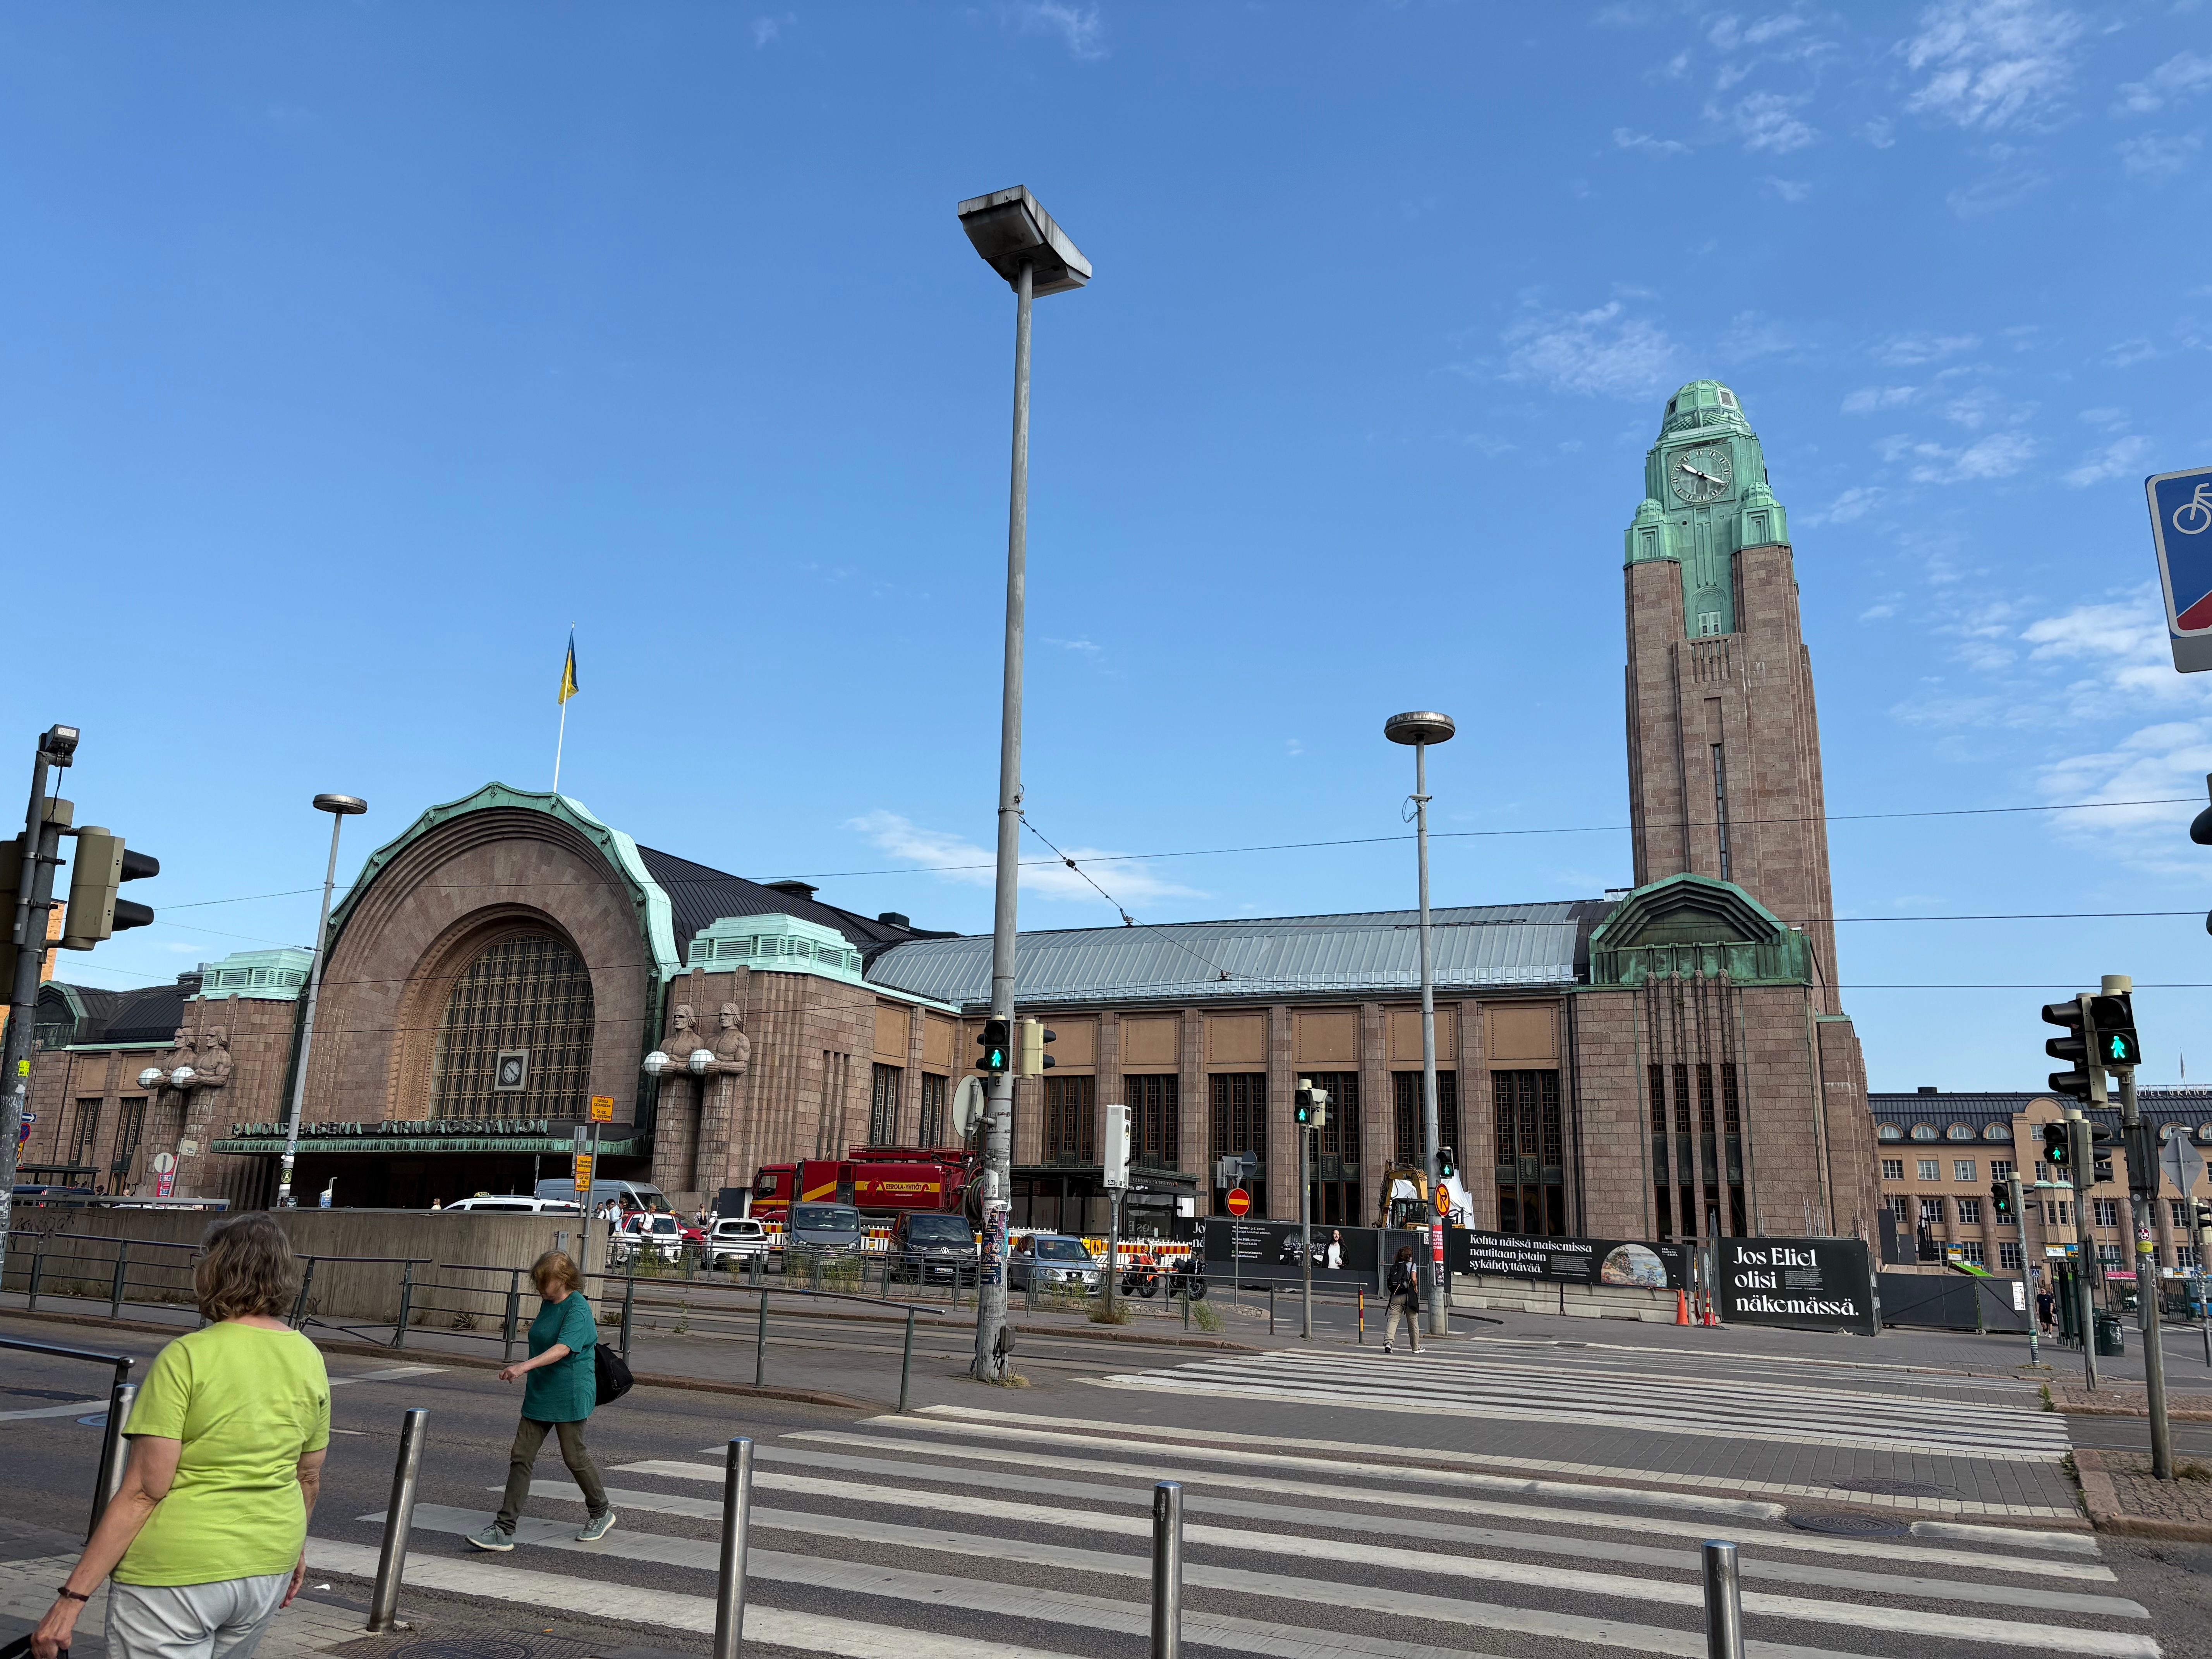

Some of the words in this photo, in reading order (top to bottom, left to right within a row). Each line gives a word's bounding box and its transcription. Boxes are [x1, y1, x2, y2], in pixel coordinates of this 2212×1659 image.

[2136, 1085, 2162, 1096] OTEL
[232, 1121, 362, 1135] RAUTATEASEMA
[1192, 1222, 1206, 1234] Jo
[1470, 1234, 1498, 1245] Kohta
[1499, 1238, 1531, 1248] näissä
[1533, 1240, 1593, 1253] maisemissa
[1470, 1248, 1516, 1259] nautitaan
[1516, 1250, 1547, 1262] jotain
[1733, 1247, 1767, 1265] Jos
[1771, 1247, 1817, 1267] Eliel
[1470, 1259, 1543, 1273] sykähdyttävää.
[1735, 1271, 1778, 1289] olisi
[1736, 1295, 1859, 1316] näkemässä.
